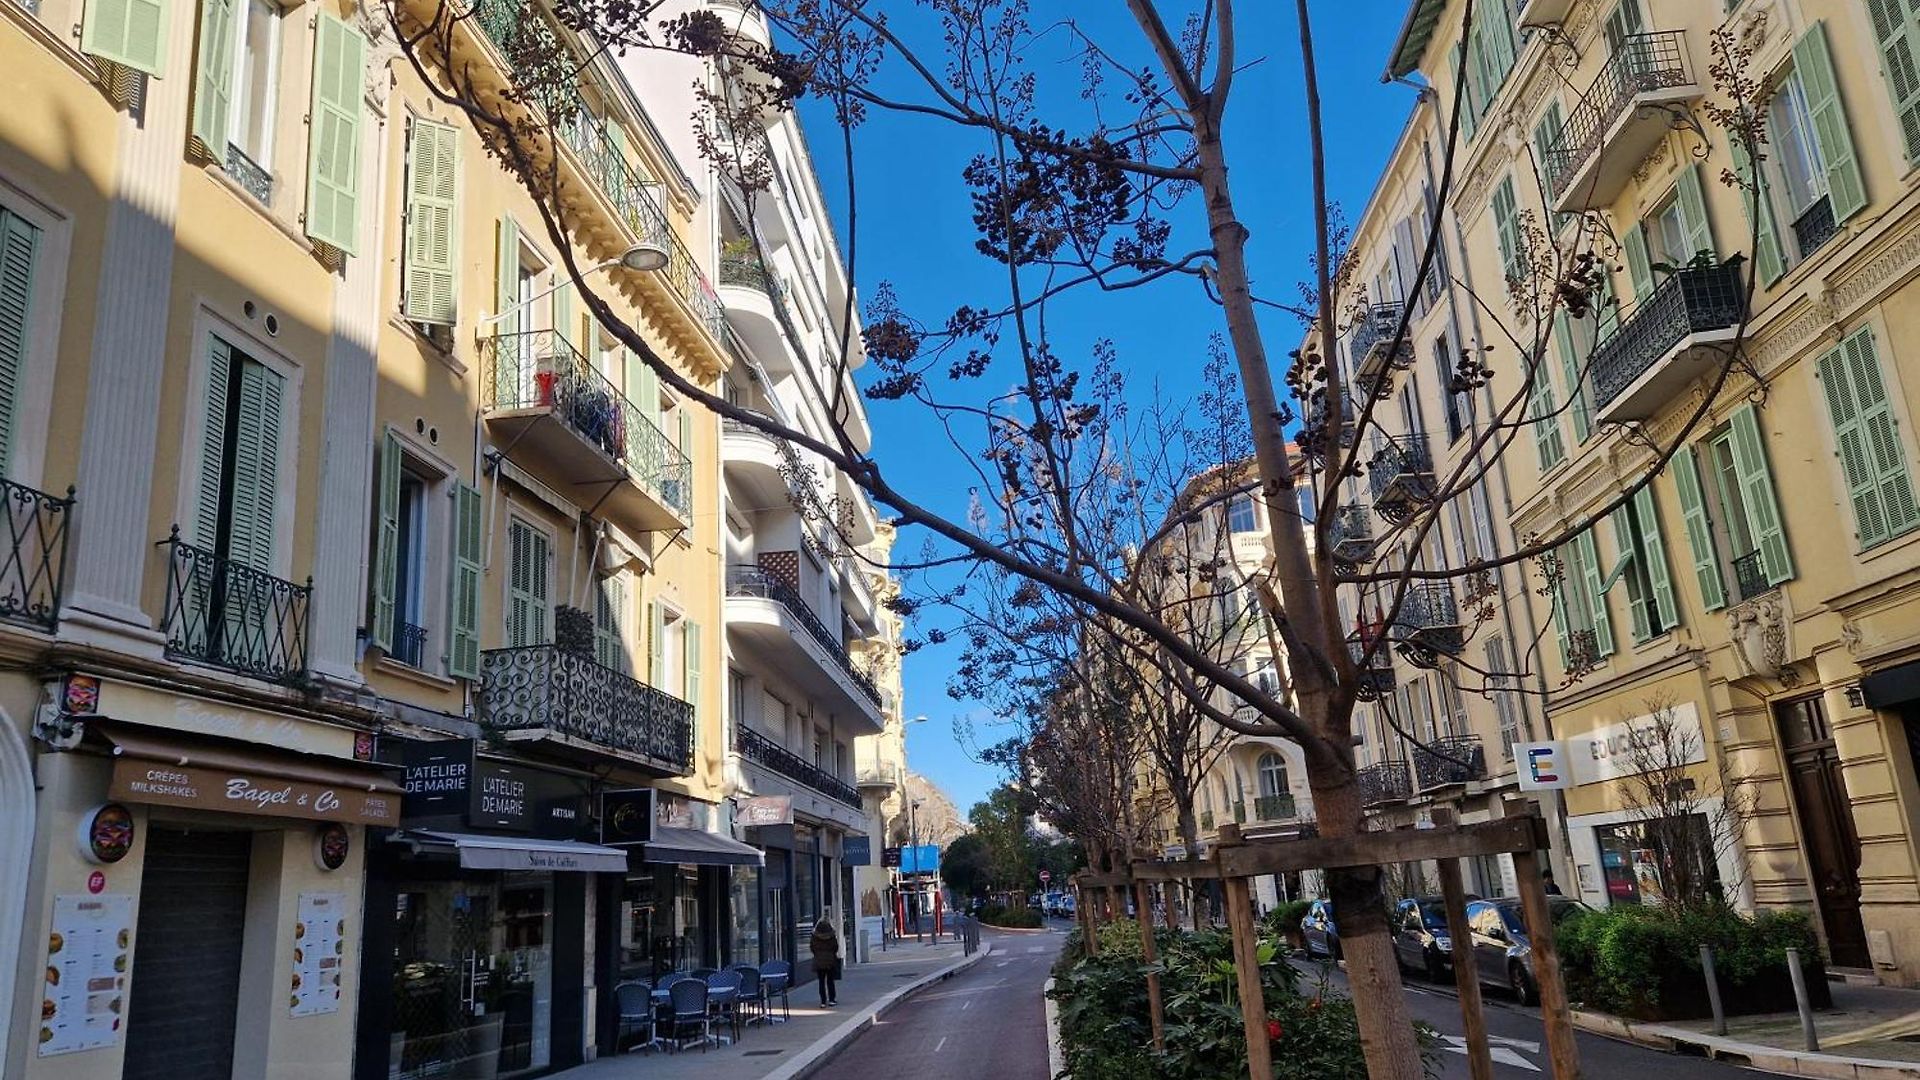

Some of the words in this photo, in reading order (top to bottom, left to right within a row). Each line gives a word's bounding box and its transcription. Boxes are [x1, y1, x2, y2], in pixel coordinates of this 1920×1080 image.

[405, 763, 467, 780] L'ATELIER
[130, 781, 198, 798] MILKSHAKES
[424, 777, 466, 792] MARIE
[483, 776, 525, 798] L'ATELIER
[224, 777, 289, 808] Bagel
[297, 793, 308, 806] &
[314, 789, 340, 812] Co
